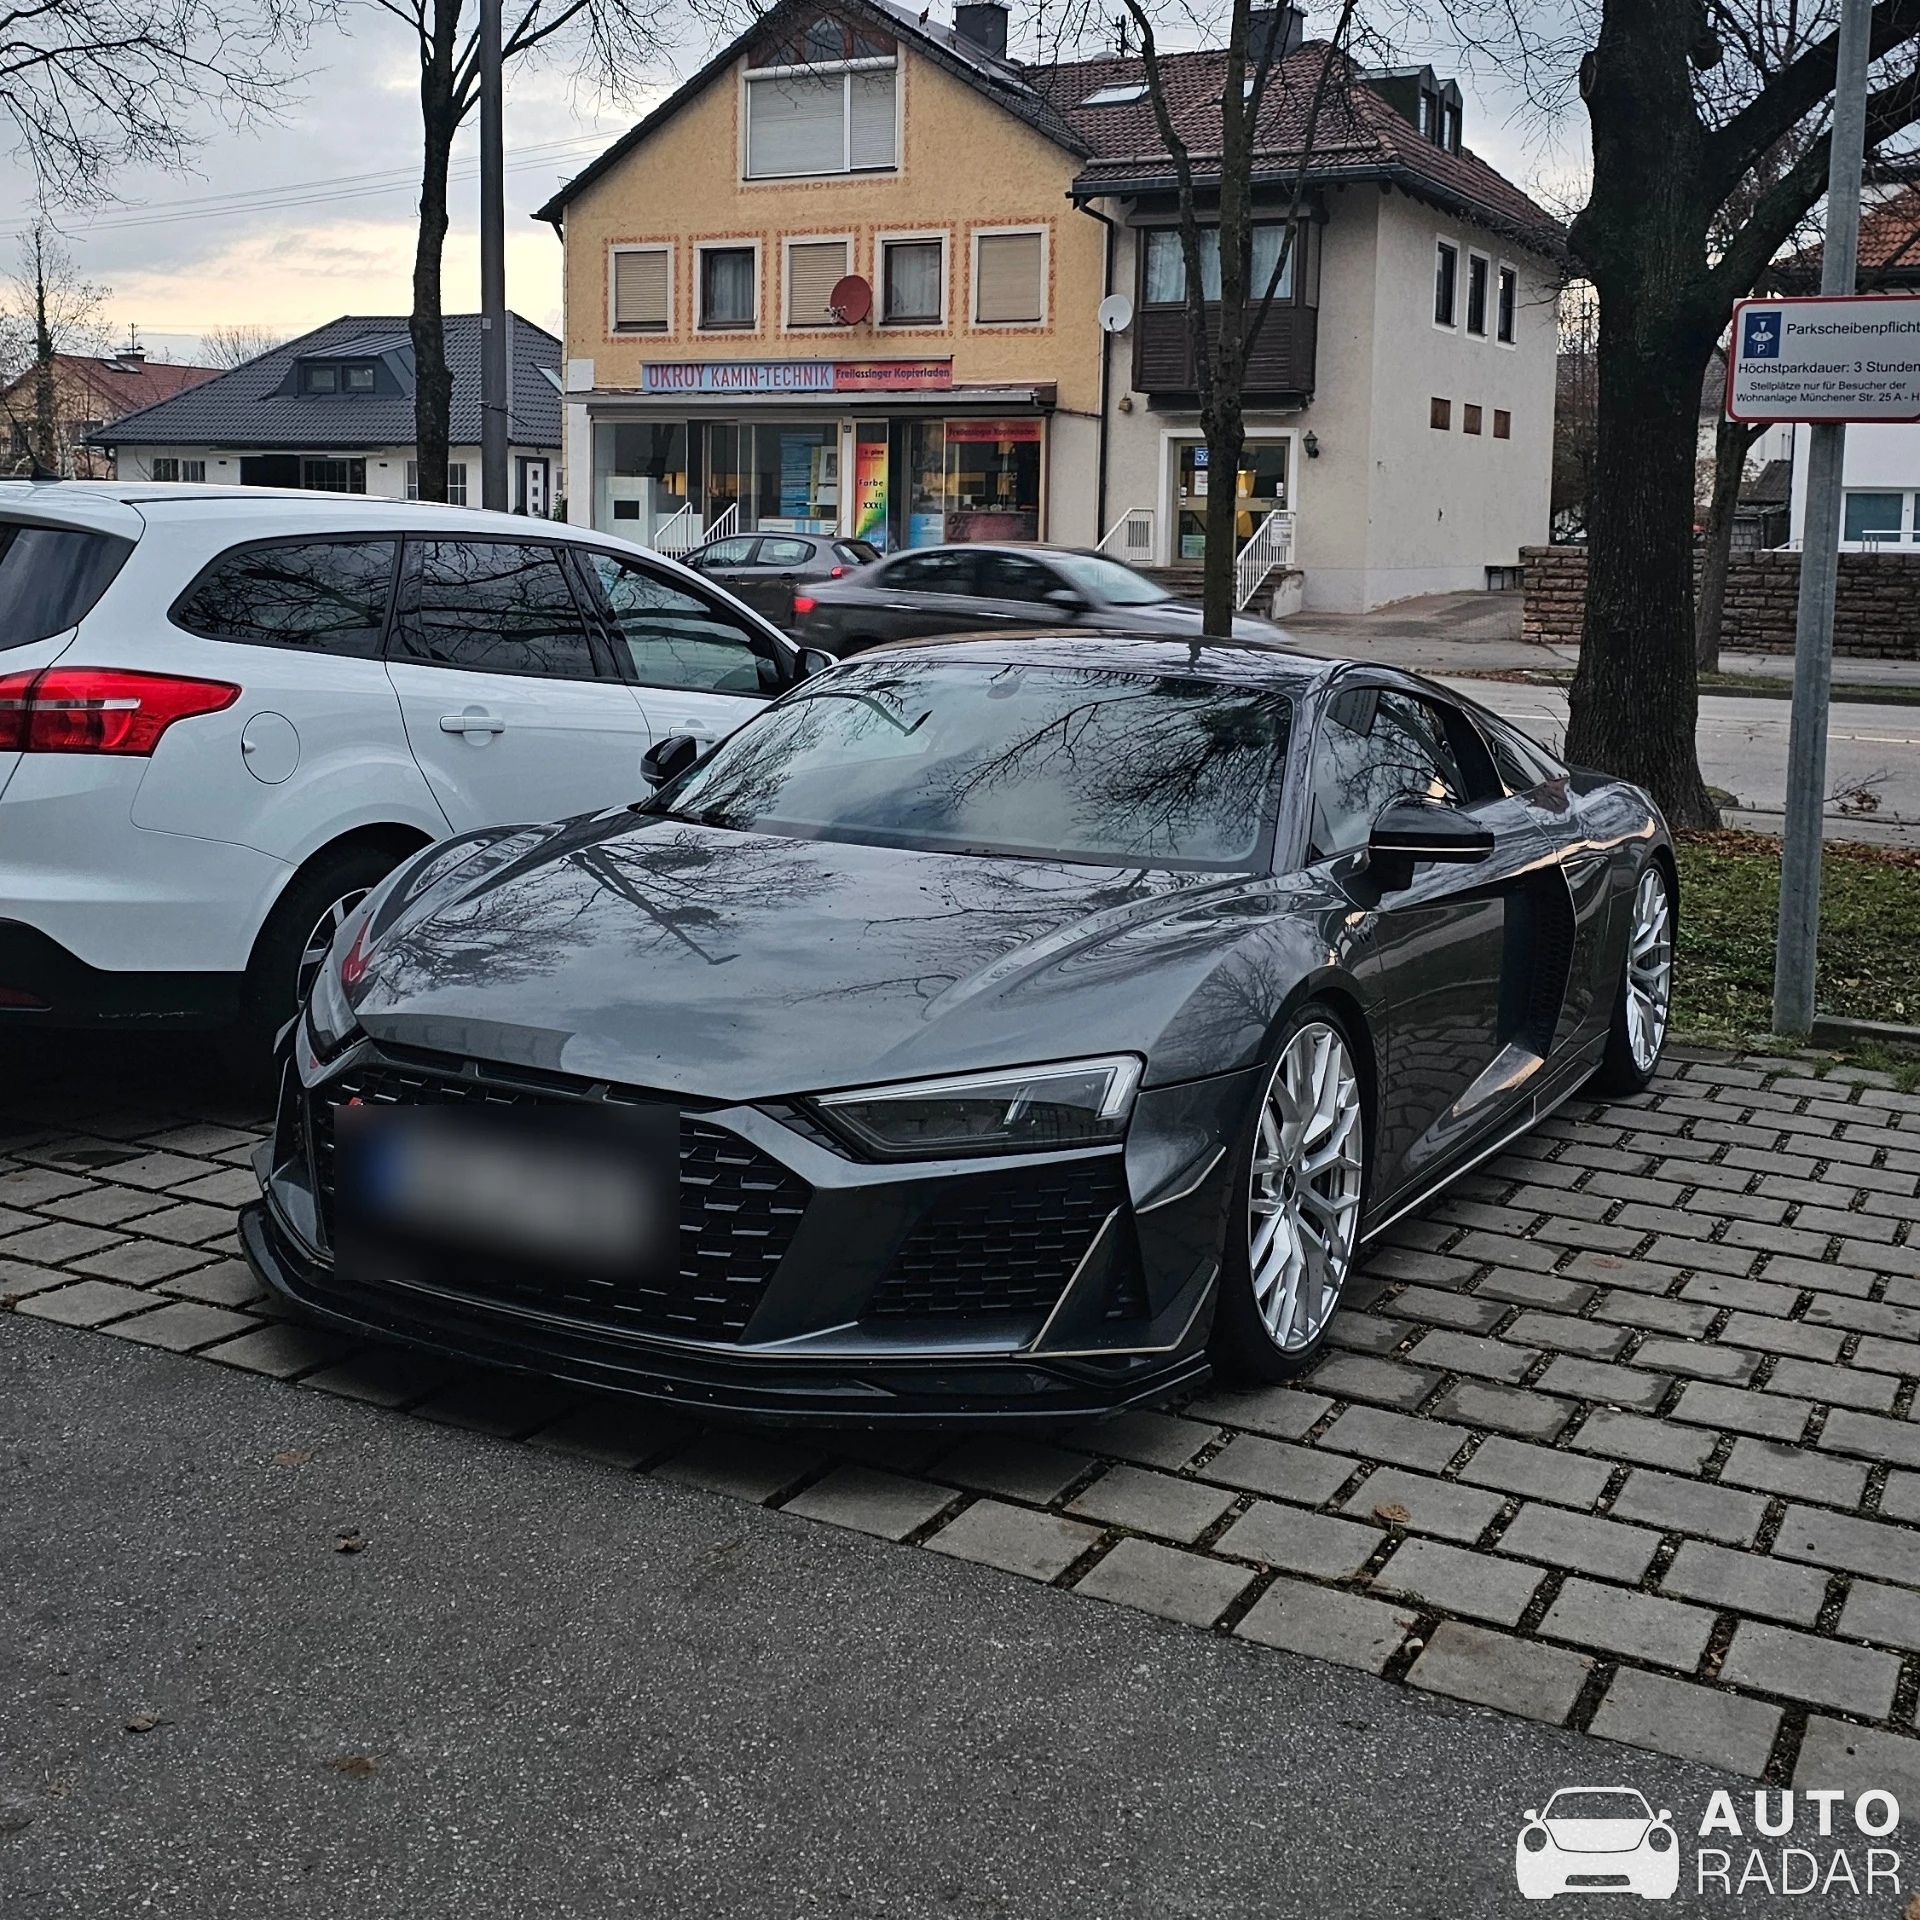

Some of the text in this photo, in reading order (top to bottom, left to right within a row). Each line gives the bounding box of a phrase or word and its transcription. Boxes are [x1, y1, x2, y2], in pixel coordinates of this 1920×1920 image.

[1786, 321, 1920, 336] Parkscheibenpflicht
[1757, 344, 1766, 354] P
[836, 367, 950, 380] Freilassinger Kopierladen
[1738, 361, 1920, 376] Höchstparkdauer: 3 Stunden
[648, 364, 830, 388] OKROY KAMIN-TECHNIK
[1750, 381, 1801, 393] Stellplätze
[1822, 381, 1836, 391] für
[1839, 381, 1887, 390] Besucher
[1889, 381, 1907, 390] der
[1736, 393, 1797, 404] Wohnanlage
[1800, 392, 1856, 402] Münchener
[1858, 393, 1876, 402] Str.
[1879, 393, 1892, 402] 25
[1893, 393, 1903, 402] A
[1911, 393, 1920, 402] H
[859, 478, 884, 487] Farbe
[875, 490, 884, 498] in
[863, 502, 883, 510] XXXL
